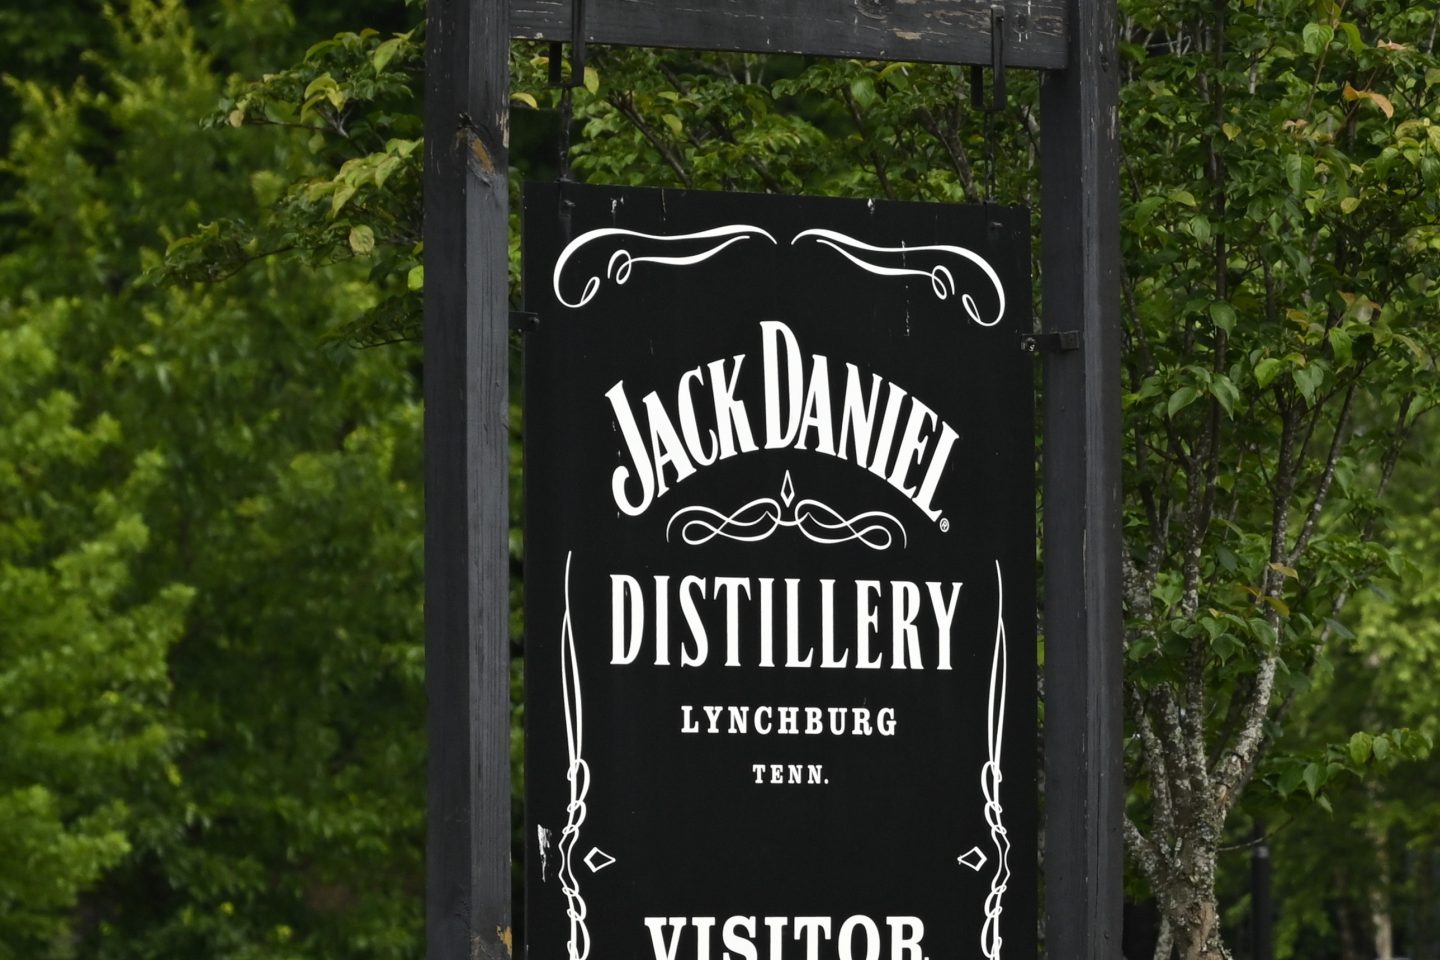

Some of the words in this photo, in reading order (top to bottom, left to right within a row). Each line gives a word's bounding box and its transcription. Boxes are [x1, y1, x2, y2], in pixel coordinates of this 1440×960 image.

[605, 354, 759, 517] JACK
[760, 321, 960, 523] DANIEL
[609, 574, 964, 671] DISTILLERY
[681, 705, 897, 736] LYNCHBURG
[752, 764, 829, 784] TENN.
